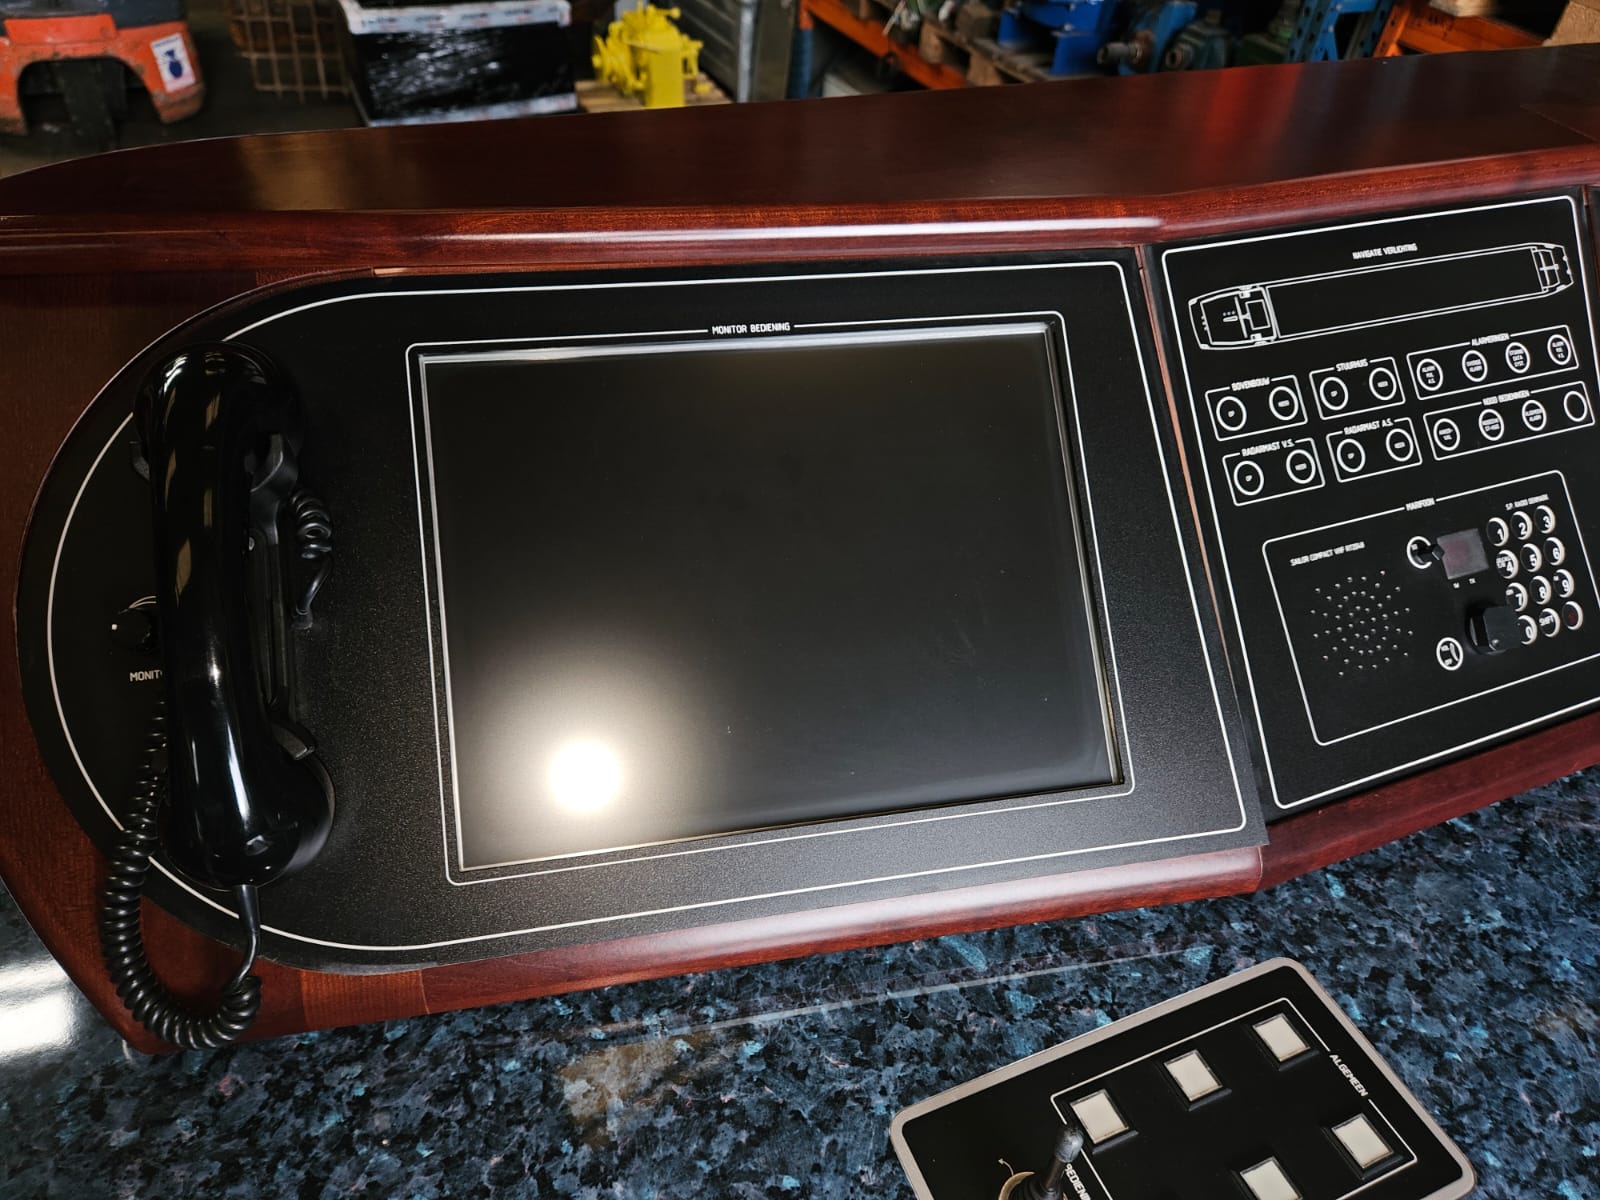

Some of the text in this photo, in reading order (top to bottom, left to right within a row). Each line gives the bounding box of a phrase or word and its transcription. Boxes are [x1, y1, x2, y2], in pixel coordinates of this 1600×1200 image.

[712, 322, 791, 335] MONITOR BEDIENING
[1344, 418, 1394, 435] RADARMAST A.S.
[1242, 439, 1295, 456] RADARMAST V.S.
[1519, 522, 1527, 535] 2
[1543, 516, 1551, 528] 3
[1497, 528, 1504, 540] 1
[1529, 554, 1537, 566] 5
[1552, 547, 1560, 560] 6
[1506, 561, 1513, 573] 4
[1562, 579, 1569, 592] 9
[1515, 593, 1522, 605] 7
[1538, 586, 1546, 599] 8
[1525, 626, 1533, 639] 0
[1329, 1054, 1368, 1097] ALGEMEEN
